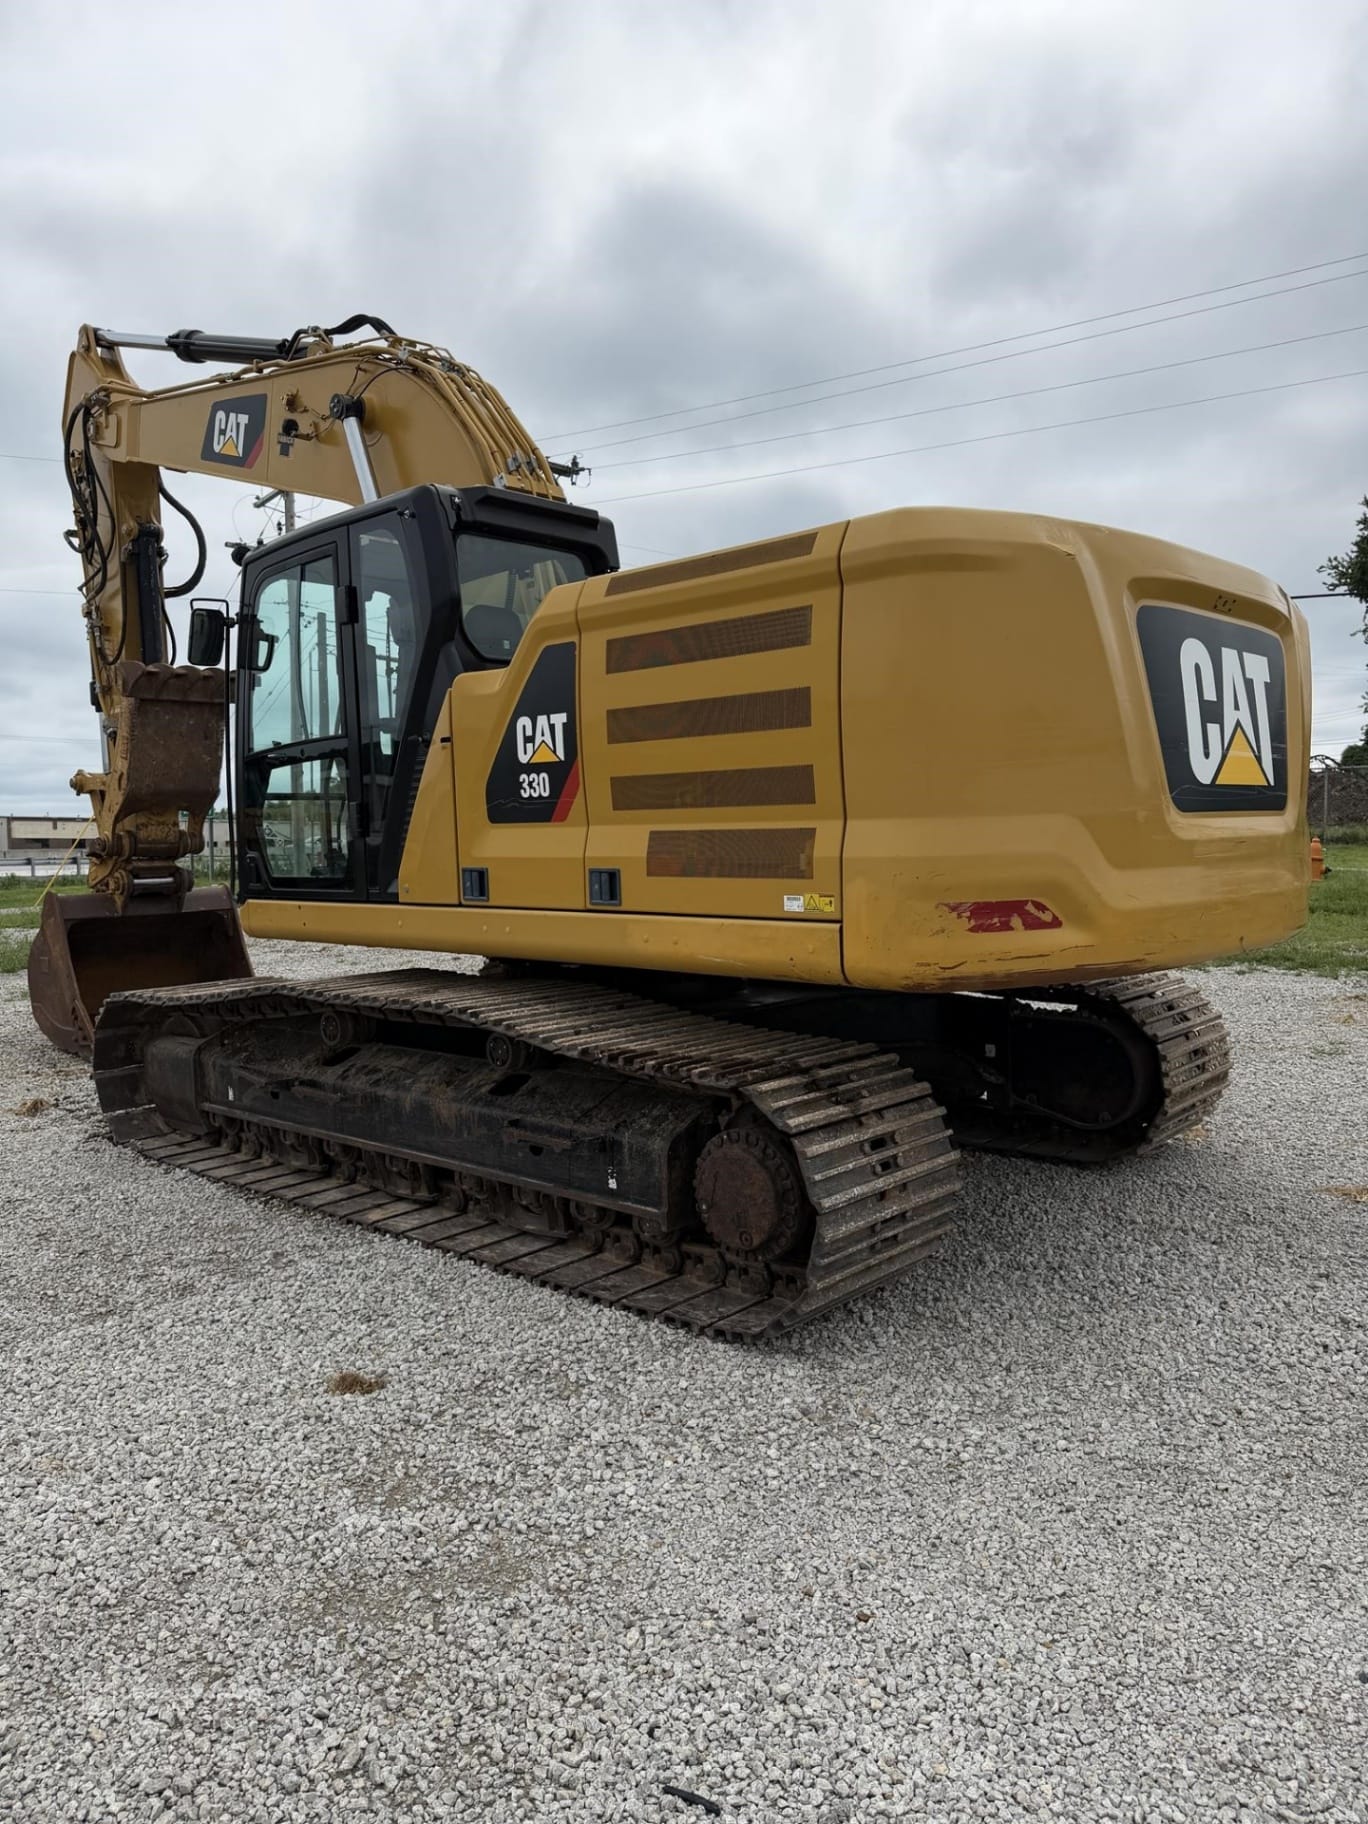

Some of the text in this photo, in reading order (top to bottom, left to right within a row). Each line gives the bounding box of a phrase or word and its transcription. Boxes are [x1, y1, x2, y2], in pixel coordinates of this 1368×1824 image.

[213, 410, 249, 457] CAT
[1180, 637, 1274, 786] CAT
[516, 712, 567, 764] CAT
[519, 772, 550, 798] 330
